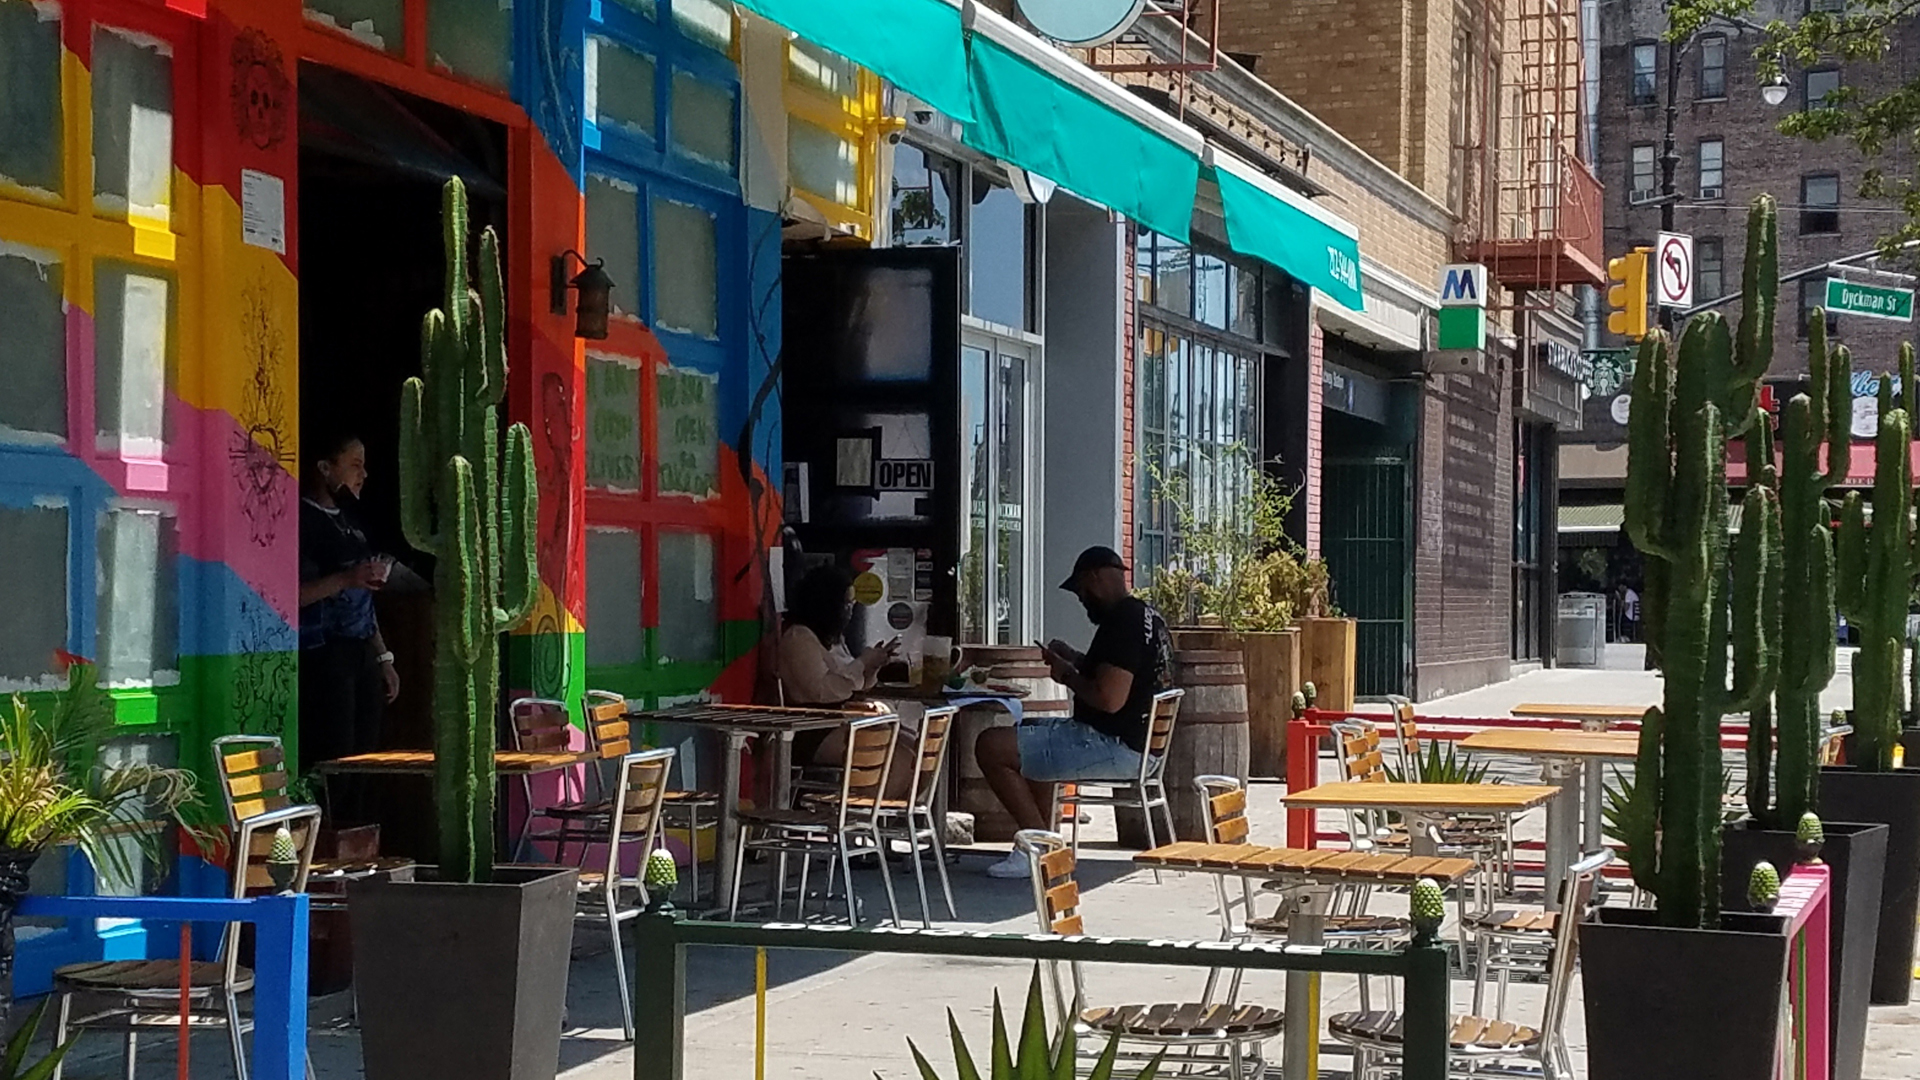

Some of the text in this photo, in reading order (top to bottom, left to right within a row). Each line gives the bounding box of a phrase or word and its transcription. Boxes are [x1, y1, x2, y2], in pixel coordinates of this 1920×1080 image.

[1841, 287, 1897, 312] Dyckman St
[879, 462, 931, 488] OPEN
[761, 922, 1324, 955] DO NOT SIT HERE
